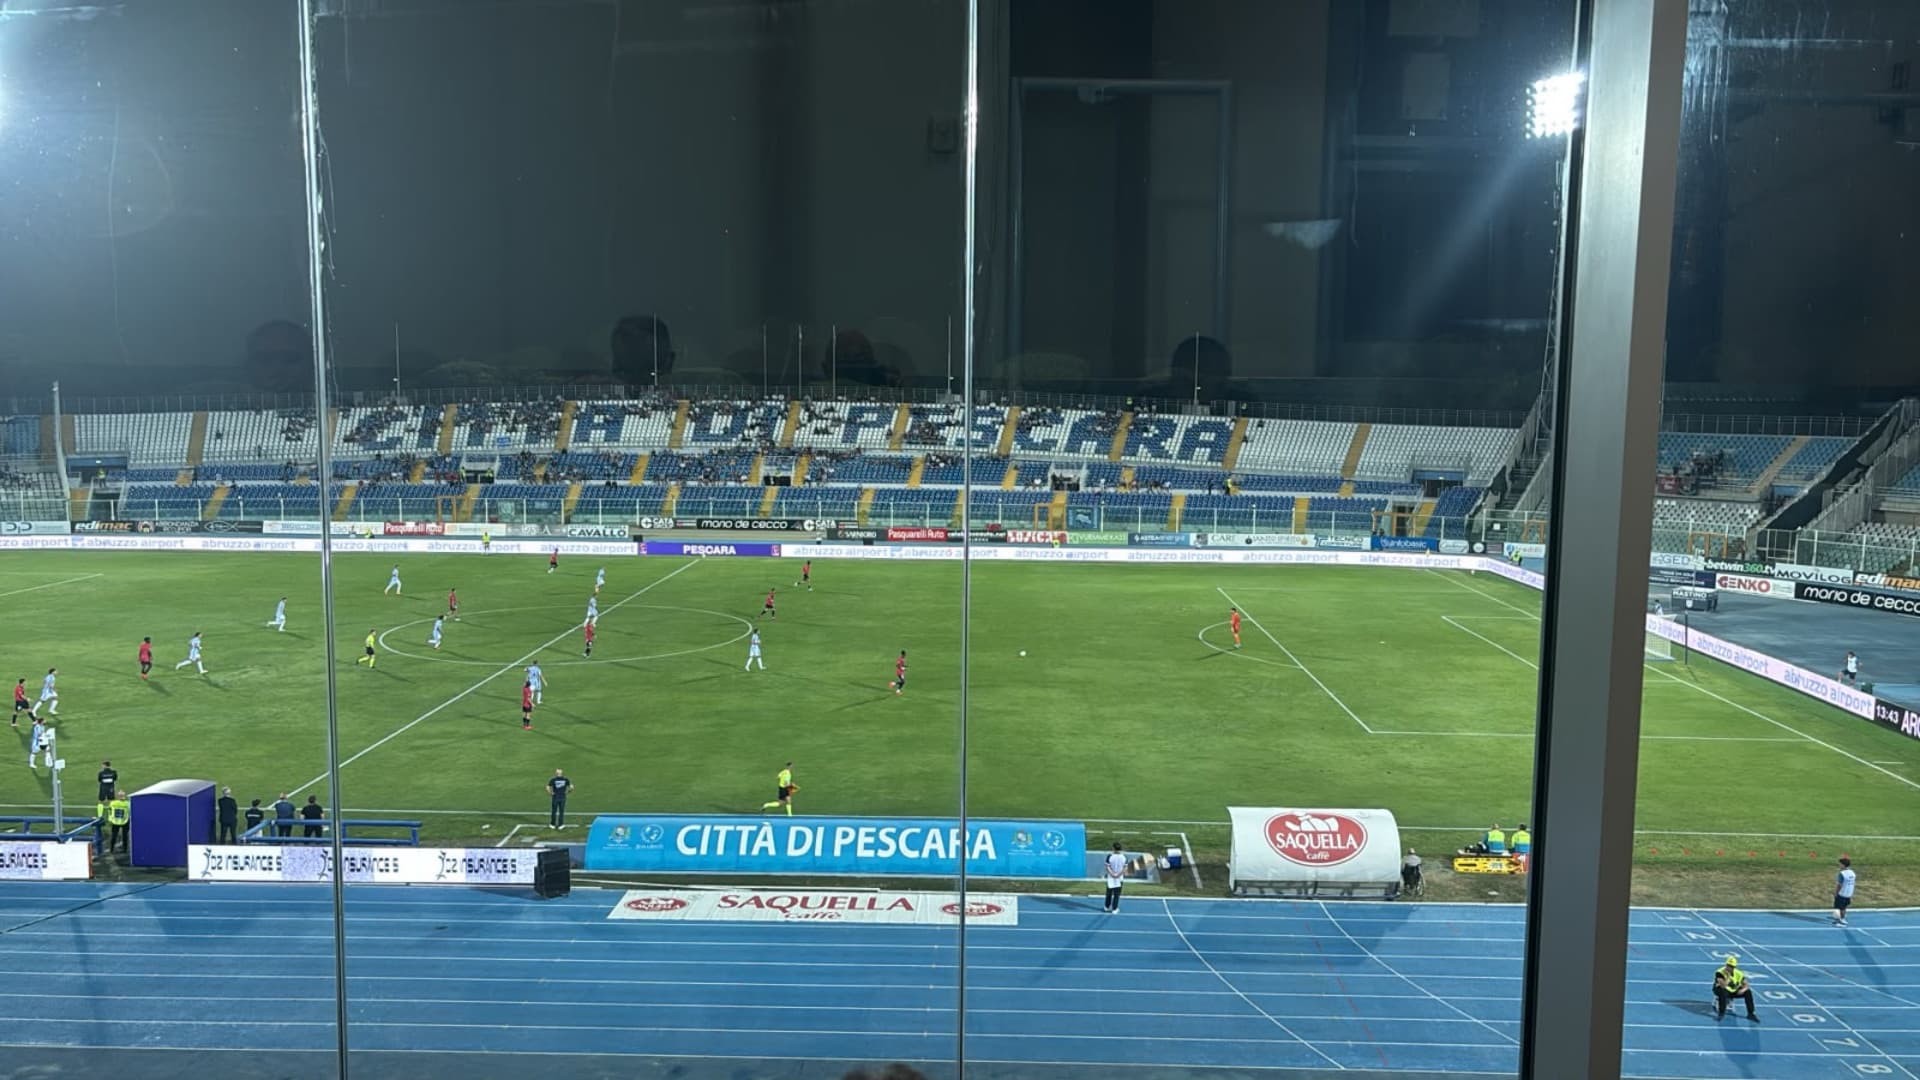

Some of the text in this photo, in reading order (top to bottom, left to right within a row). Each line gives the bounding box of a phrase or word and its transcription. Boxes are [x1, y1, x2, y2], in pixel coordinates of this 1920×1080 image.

[75, 521, 133, 531] edimac
[568, 528, 627, 537] CAVALLO
[888, 529, 926, 541] Pasquarelli
[927, 530, 945, 539] Auto
[22, 537, 68, 549] airport
[140, 538, 184, 550] airport
[201, 539, 296, 551] abruzzo airport
[428, 541, 475, 551] abruzzo
[541, 543, 635, 555] abruzzo airport
[683, 544, 736, 555] PESCARA
[793, 546, 888, 558] abruzzo airport
[1015, 549, 1109, 561] abruzzo airport
[1128, 550, 1223, 563] abruzzo airport
[1243, 552, 1339, 564] abruzzo airport
[1360, 553, 1411, 564] abruzzo
[1717, 576, 1770, 593] GENKO
[1804, 586, 1847, 602] mario
[1850, 591, 1870, 605] de
[1696, 636, 1769, 673] abruzzo airport
[1784, 668, 1872, 713] abruzzo airport
[1876, 704, 1899, 724] 13:43
[676, 822, 998, 860] CITTÀ DI PESCARA
[1275, 833, 1358, 854] SAQUELLA
[718, 894, 914, 913] SAQUELLA
[1687, 931, 1717, 942] 2
[1763, 989, 1798, 1001] 5
[1793, 1012, 1827, 1025] 6
[1822, 1037, 1861, 1048] 7
[1855, 1063, 1894, 1075] 8
